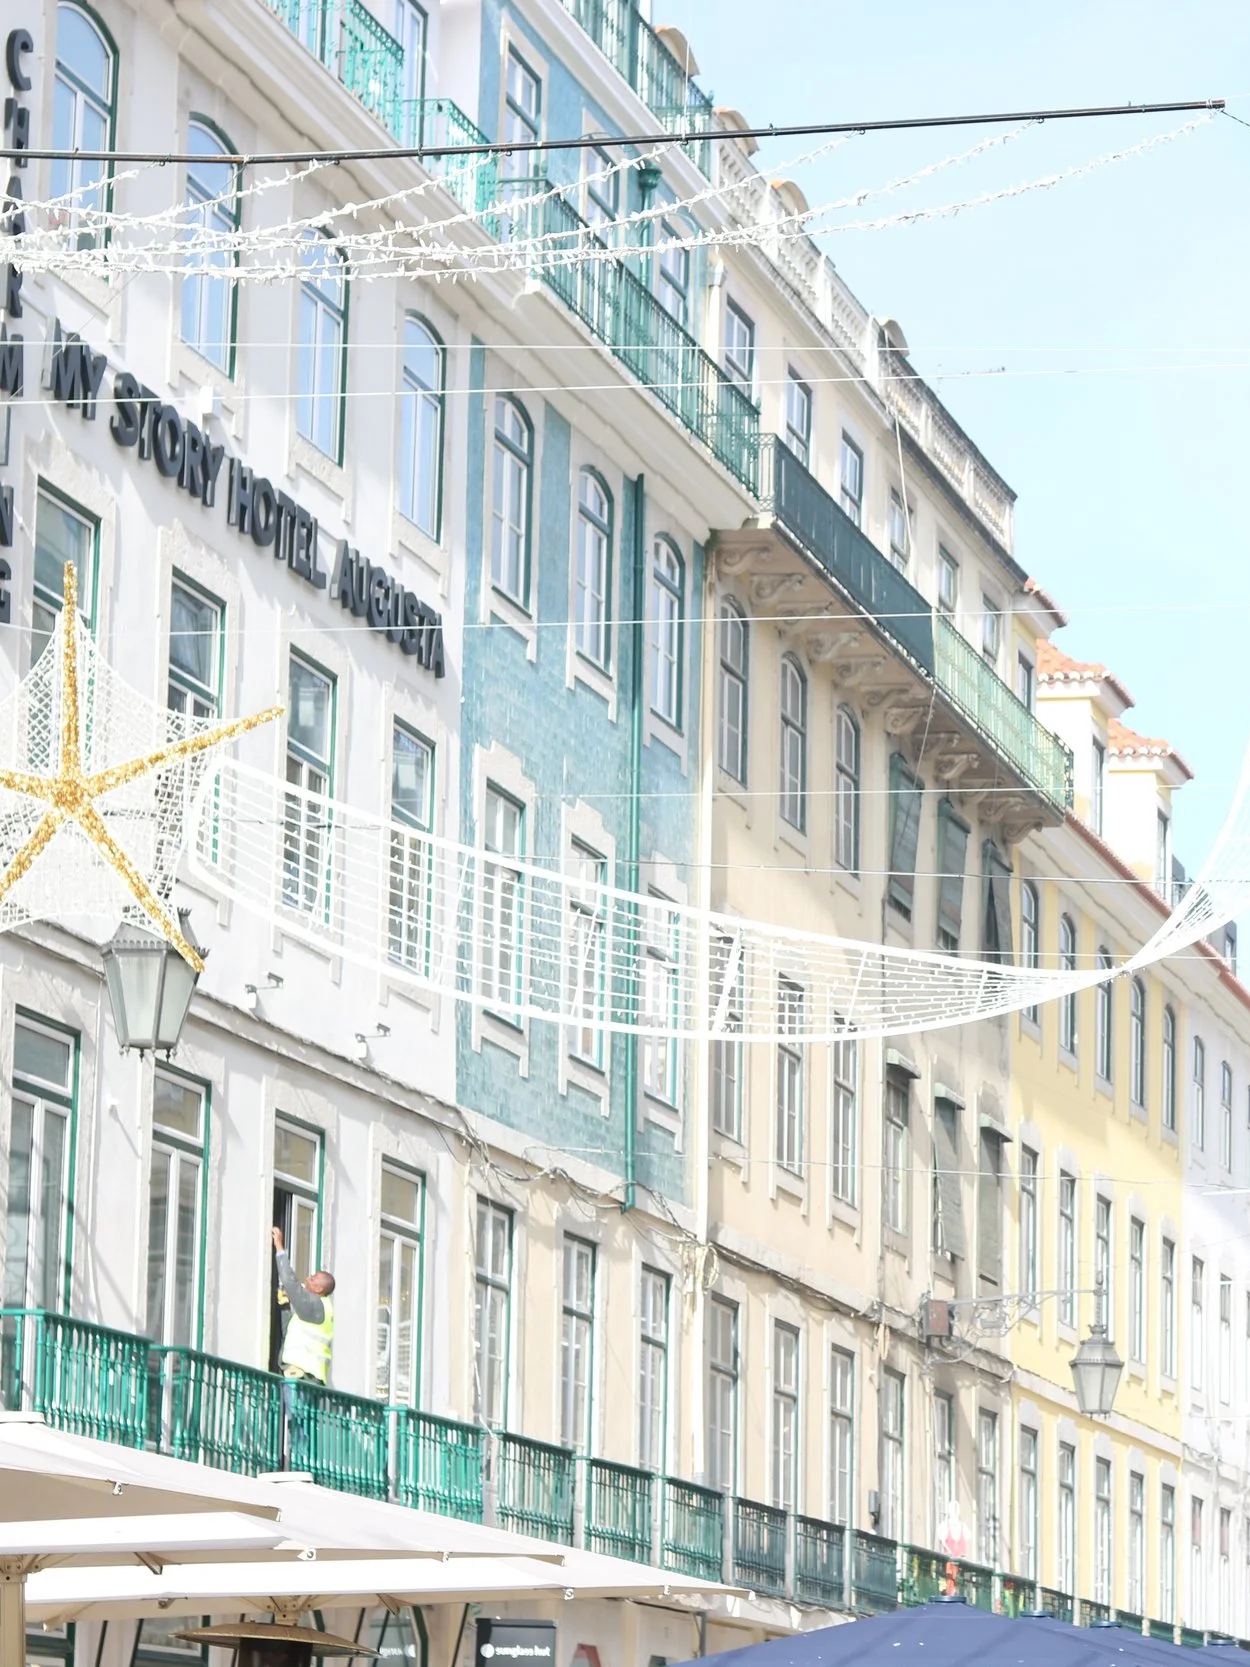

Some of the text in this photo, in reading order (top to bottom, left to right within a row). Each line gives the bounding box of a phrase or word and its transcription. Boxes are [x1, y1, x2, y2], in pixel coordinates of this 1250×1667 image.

[41, 317, 446, 679] MY STORY HOTEL AUGUSTA
